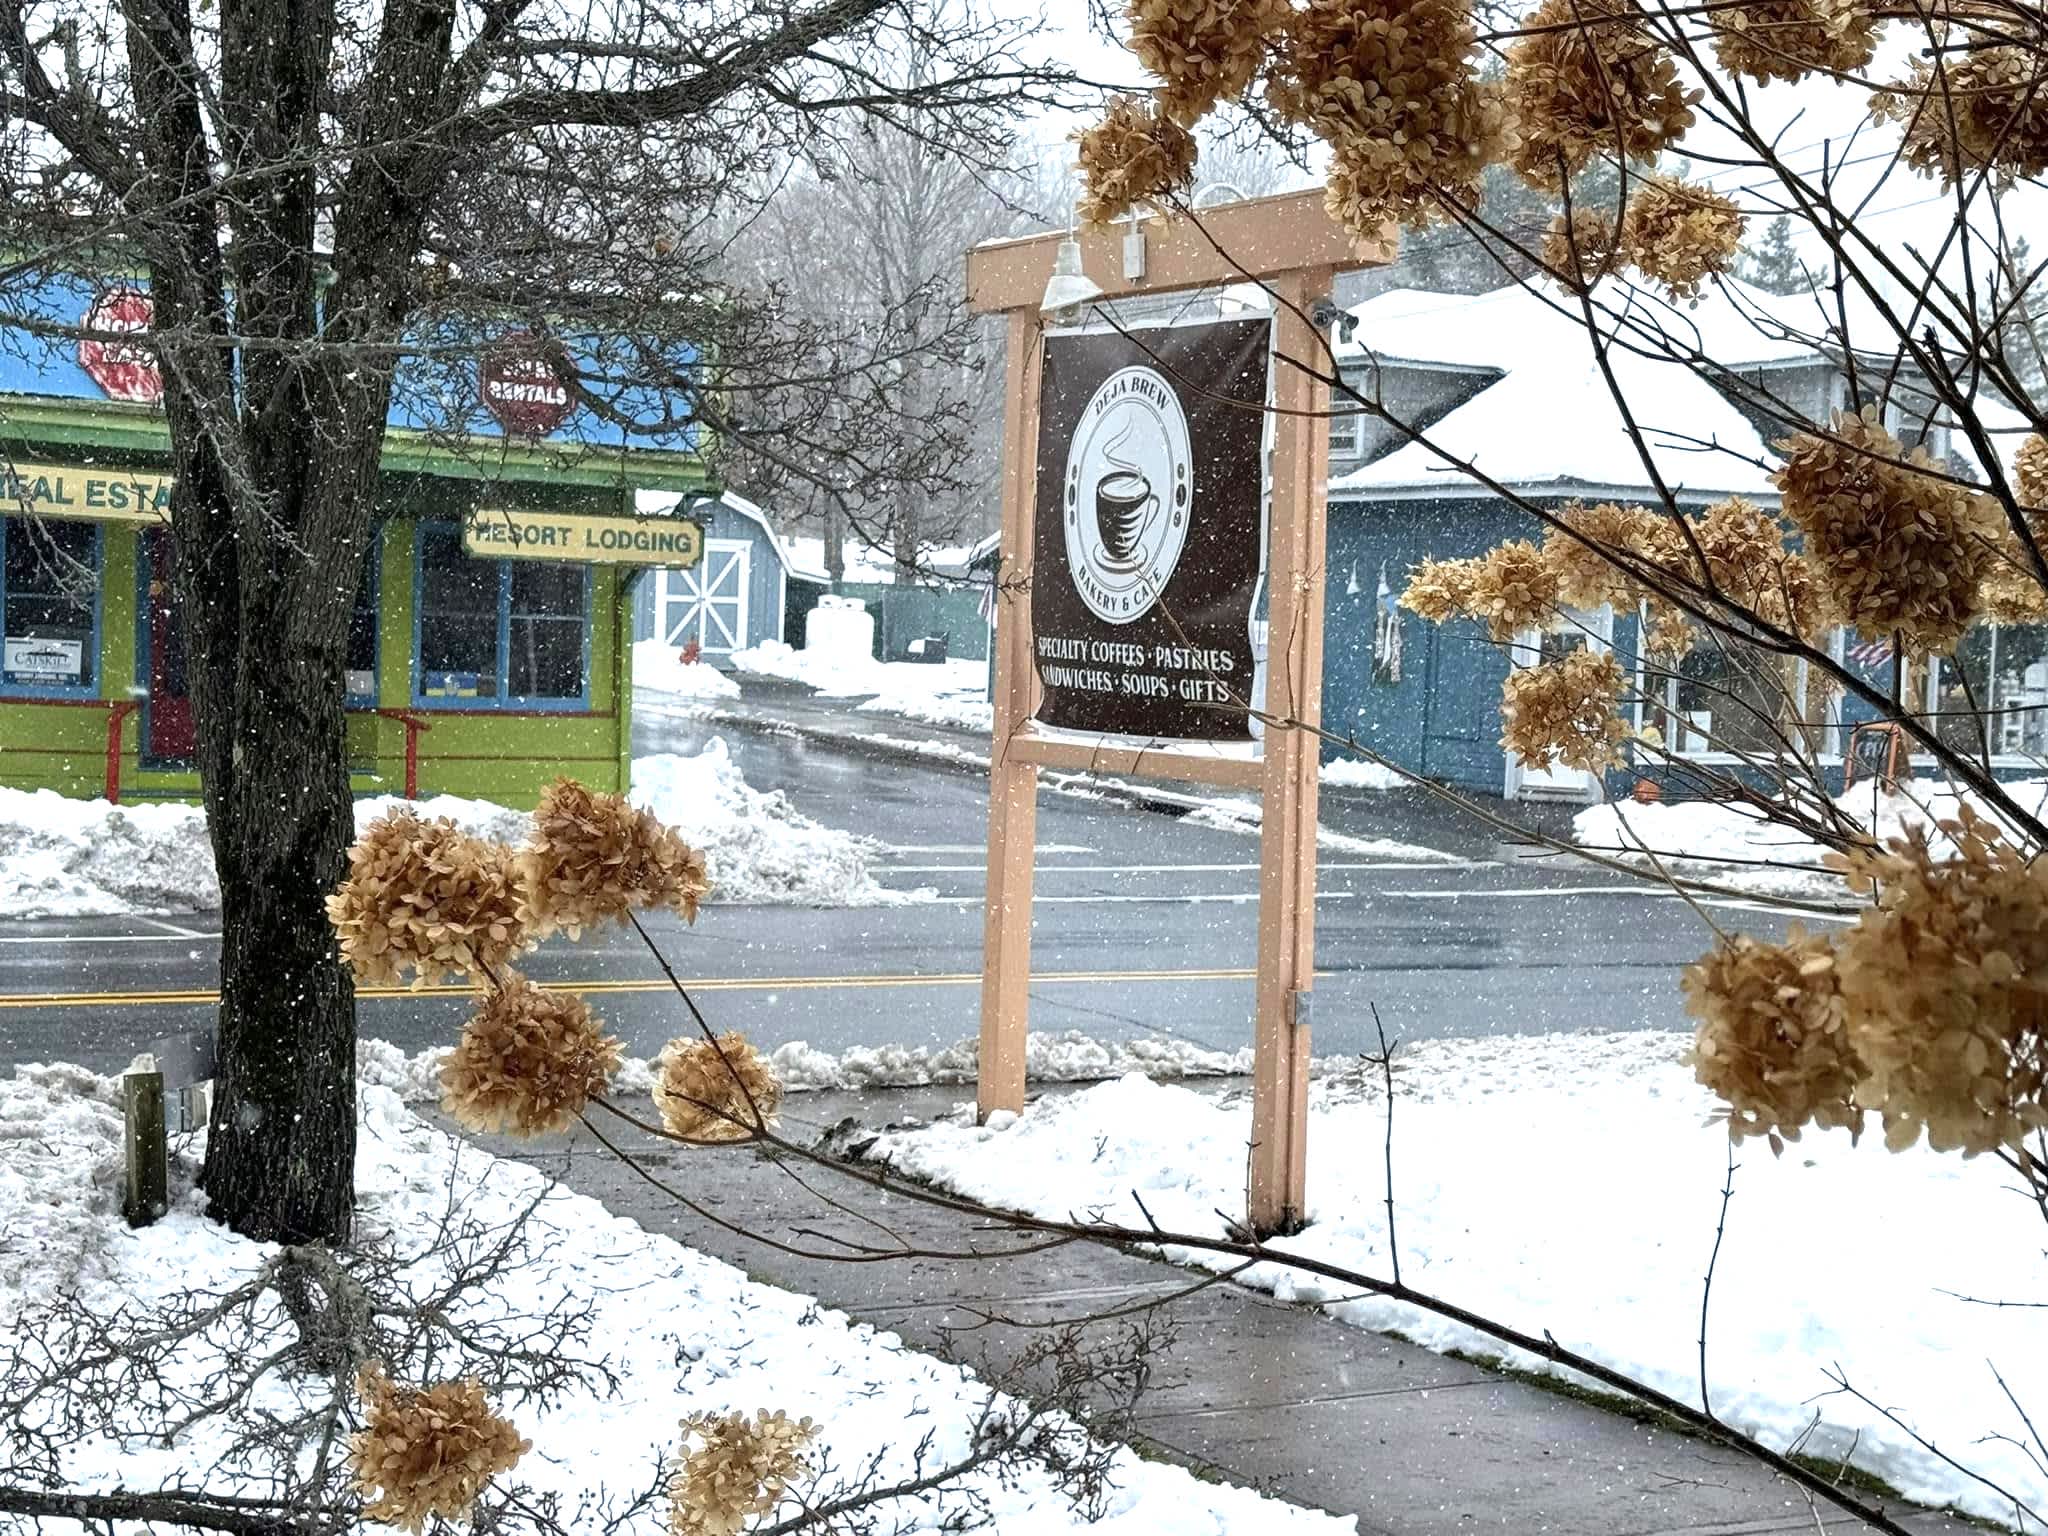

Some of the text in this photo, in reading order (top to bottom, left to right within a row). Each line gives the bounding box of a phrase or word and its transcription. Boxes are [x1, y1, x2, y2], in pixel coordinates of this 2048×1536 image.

[488, 381, 567, 405] RENTALS
[1095, 377, 1170, 415] DEJA BREW
[0, 473, 172, 512] EAL ESTA
[586, 528, 692, 553] LODGING
[1079, 565, 1118, 611] BAKERY
[1122, 596, 1130, 611] &
[1038, 636, 1234, 672] SPECIALTY COFFEES PASTRIES
[1122, 673, 1169, 698] SOUPS
[1179, 678, 1230, 702] GIFTS
